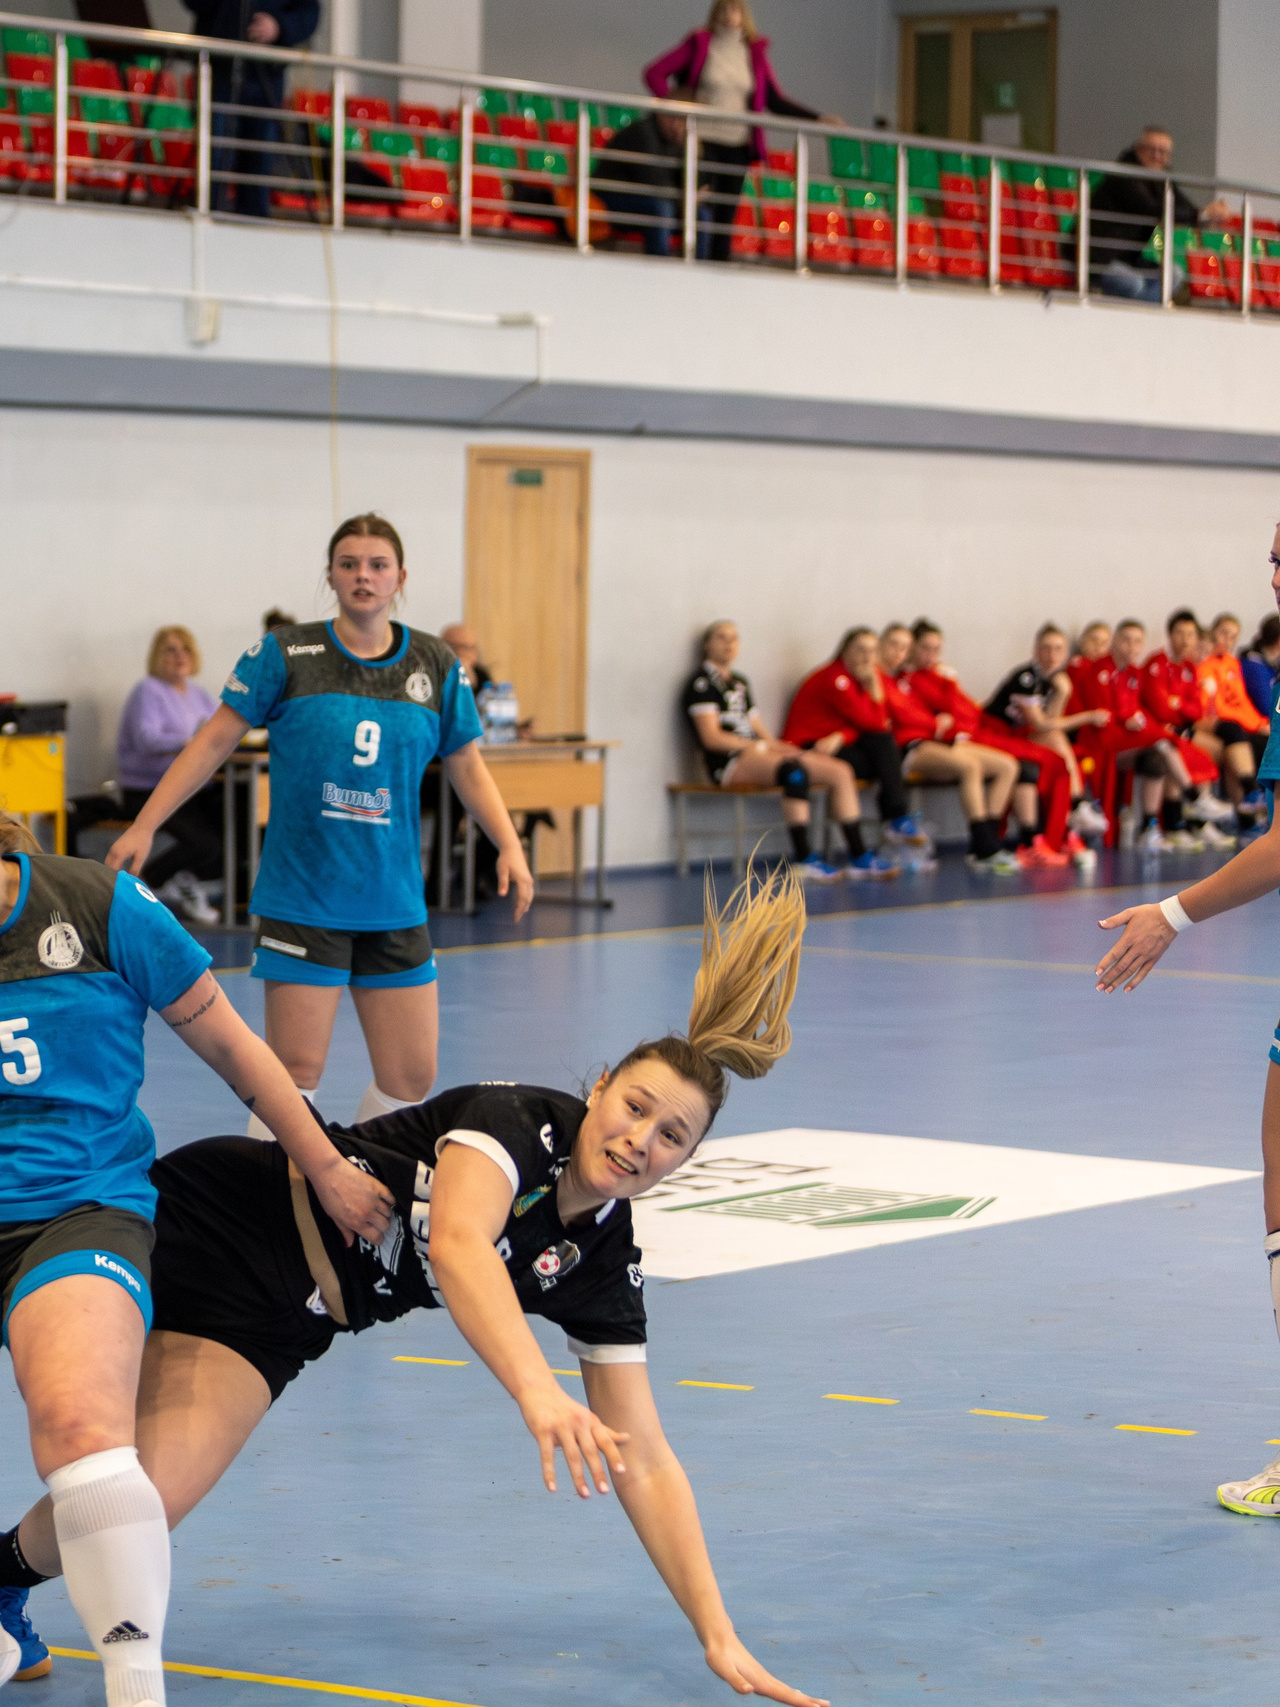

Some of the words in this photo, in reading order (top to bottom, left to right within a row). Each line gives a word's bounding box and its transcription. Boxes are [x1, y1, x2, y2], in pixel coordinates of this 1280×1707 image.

[287, 644, 326, 656] Kempa
[352, 720, 381, 766] 9
[94, 1253, 141, 1293] Kempa
[102, 1630, 149, 1643] adidas
